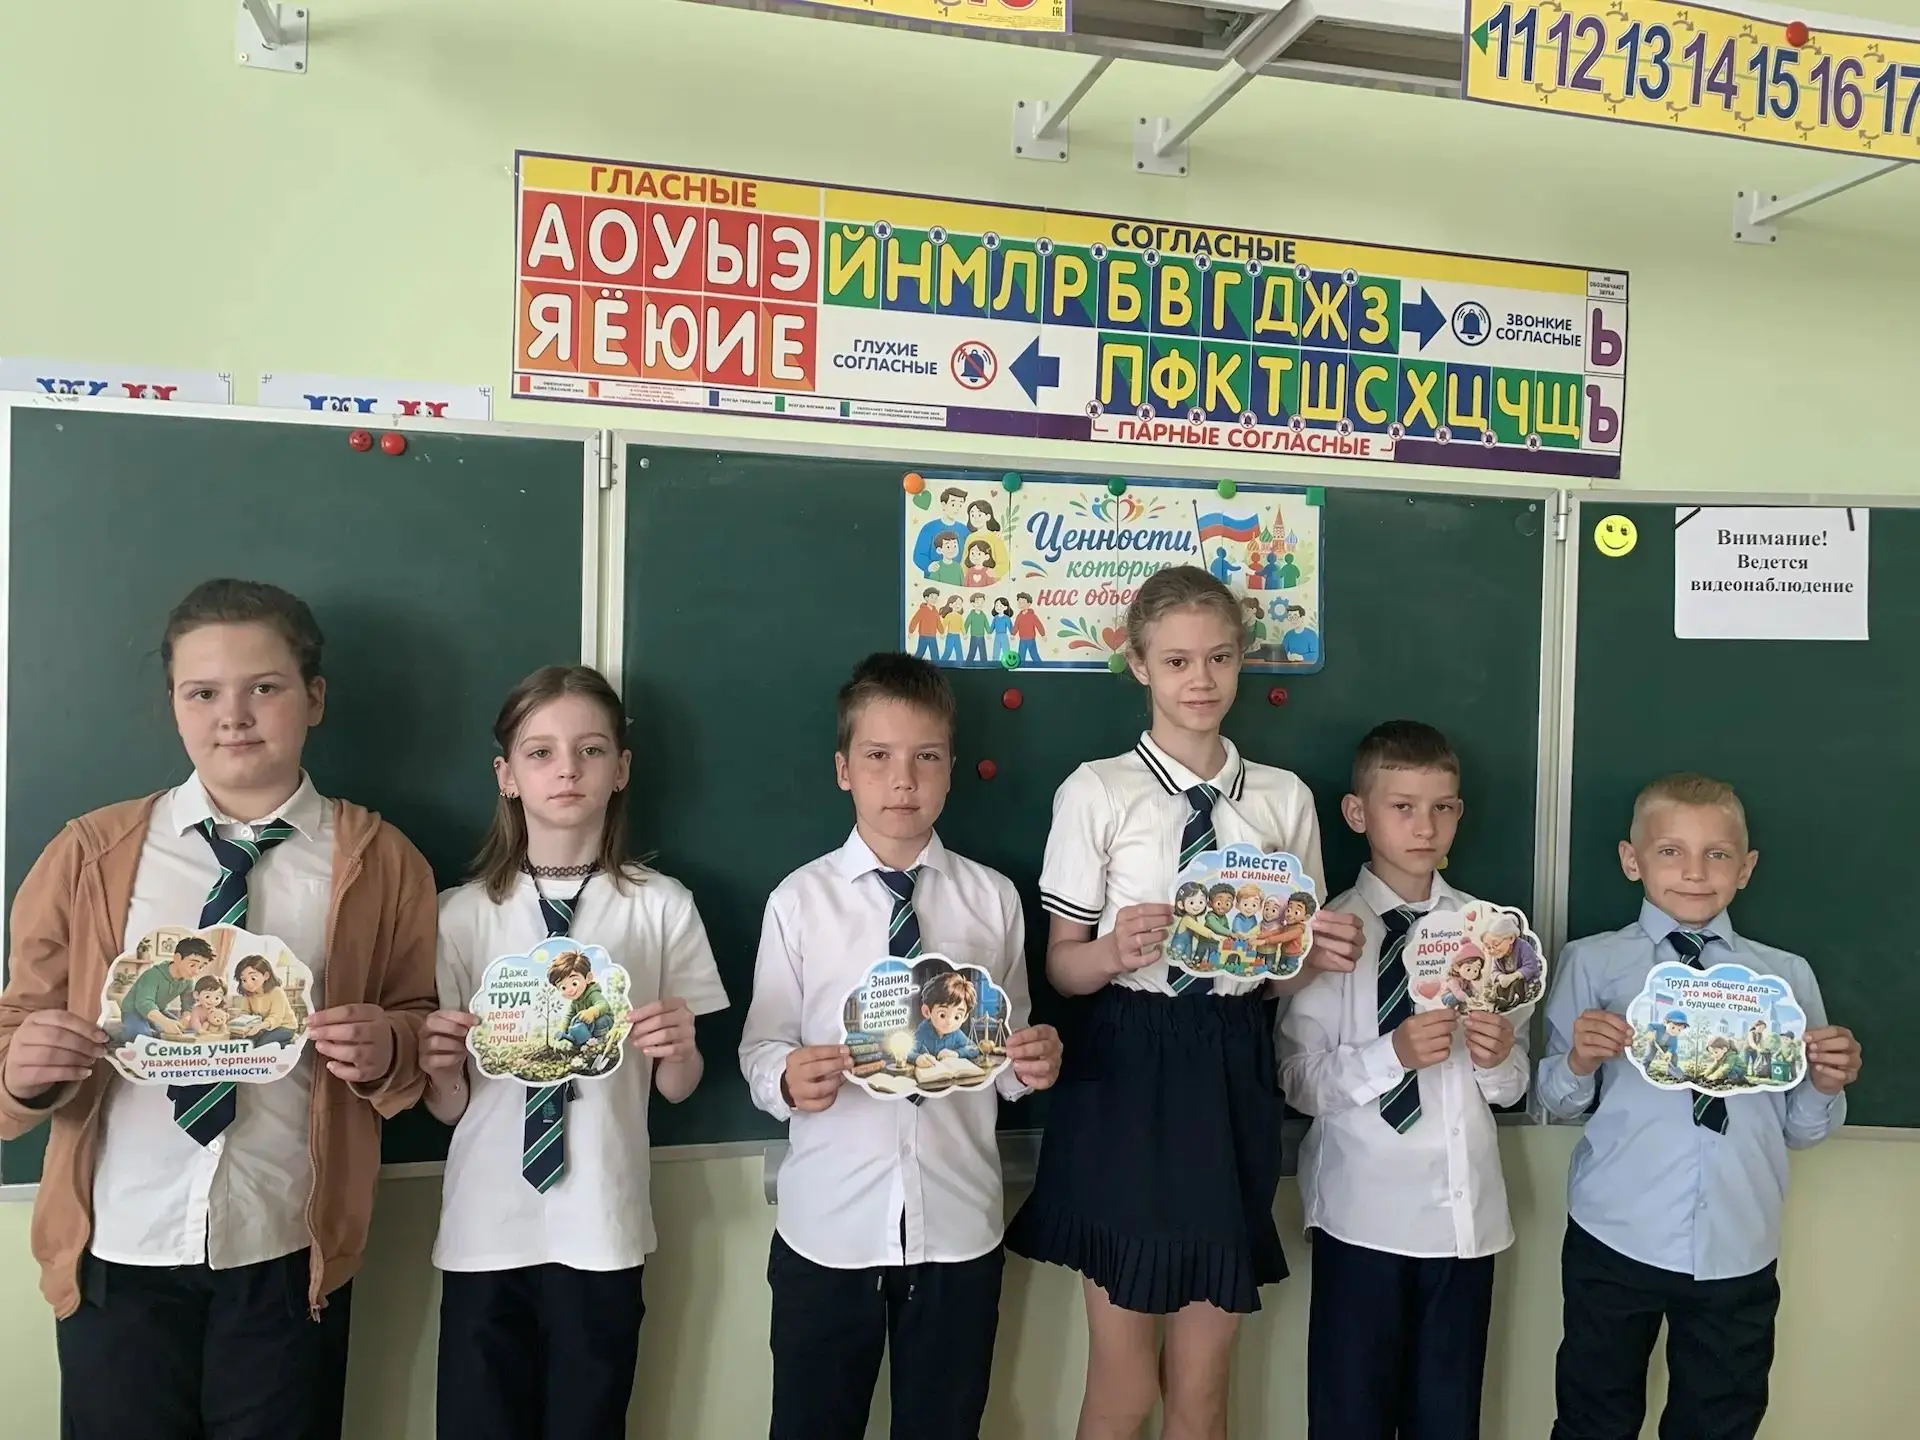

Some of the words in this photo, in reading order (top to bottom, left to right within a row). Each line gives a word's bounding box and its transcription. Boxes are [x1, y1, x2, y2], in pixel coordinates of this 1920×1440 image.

[1488, 2, 1539, 83] 11
[1547, 11, 1607, 93] 12
[1616, 20, 1672, 101] 13
[1683, 30, 1739, 111] 14
[1748, 44, 1800, 120] 15
[1809, 54, 1865, 130] 16
[590, 166, 757, 208] ГЛАСНЫЕ
[1111, 222, 1297, 264] СОГЛАСНЫЕ
[1506, 313, 1572, 331] ЗВОНКИЕ
[1496, 328, 1582, 348] СОГЛАСНЫЕ
[852, 338, 918, 358] ГЛУХИЕ
[833, 354, 938, 376] СОГЛАСНЫЕ
[1118, 420, 1219, 448] ПАРНЫЕ
[1228, 427, 1370, 457] СОГЛАСНЫЕ
[1026, 511, 1198, 563] Ценности,
[1717, 529, 1828, 546] Внимание!
[1737, 554, 1808, 571] Ведется
[1691, 577, 1854, 593] видеонаблюдение
[1037, 587, 1078, 606] нас
[1226, 851, 1288, 872] Вместе
[1220, 871, 1238, 880] мы
[1242, 871, 1291, 884] сильнее!
[1421, 929, 1428, 939] Я
[1417, 940, 1459, 956] добро
[1416, 957, 1446, 967] каждый
[499, 967, 528, 979] Даже
[1419, 967, 1442, 976] день!
[490, 978, 539, 989] маленький
[871, 974, 910, 988] Знания
[1665, 978, 1690, 990] Труд
[1692, 980, 1709, 989] для
[1711, 981, 1745, 991] общего
[1747, 984, 1769, 994] дела
[488, 991, 531, 1008] труд
[870, 988, 910, 999] совесть
[1682, 989, 1699, 998] это
[1702, 990, 1723, 999] мой
[1726, 993, 1757, 1004] вклад
[869, 1000, 896, 1009] самое
[1686, 998, 1725, 1010] будущее
[1728, 1003, 1763, 1014] страны.
[487, 1010, 525, 1021] делает
[863, 1007, 908, 1020] надёжное
[493, 1022, 516, 1033] мир
[863, 1018, 908, 1029] богатство.
[488, 1034, 528, 1045] лучше!
[145, 1042, 201, 1056] Семья
[208, 1042, 249, 1058] учит
[141, 1056, 210, 1068] уважению,
[215, 1056, 277, 1068] терпению
[161, 1067, 272, 1078] ответственности.
